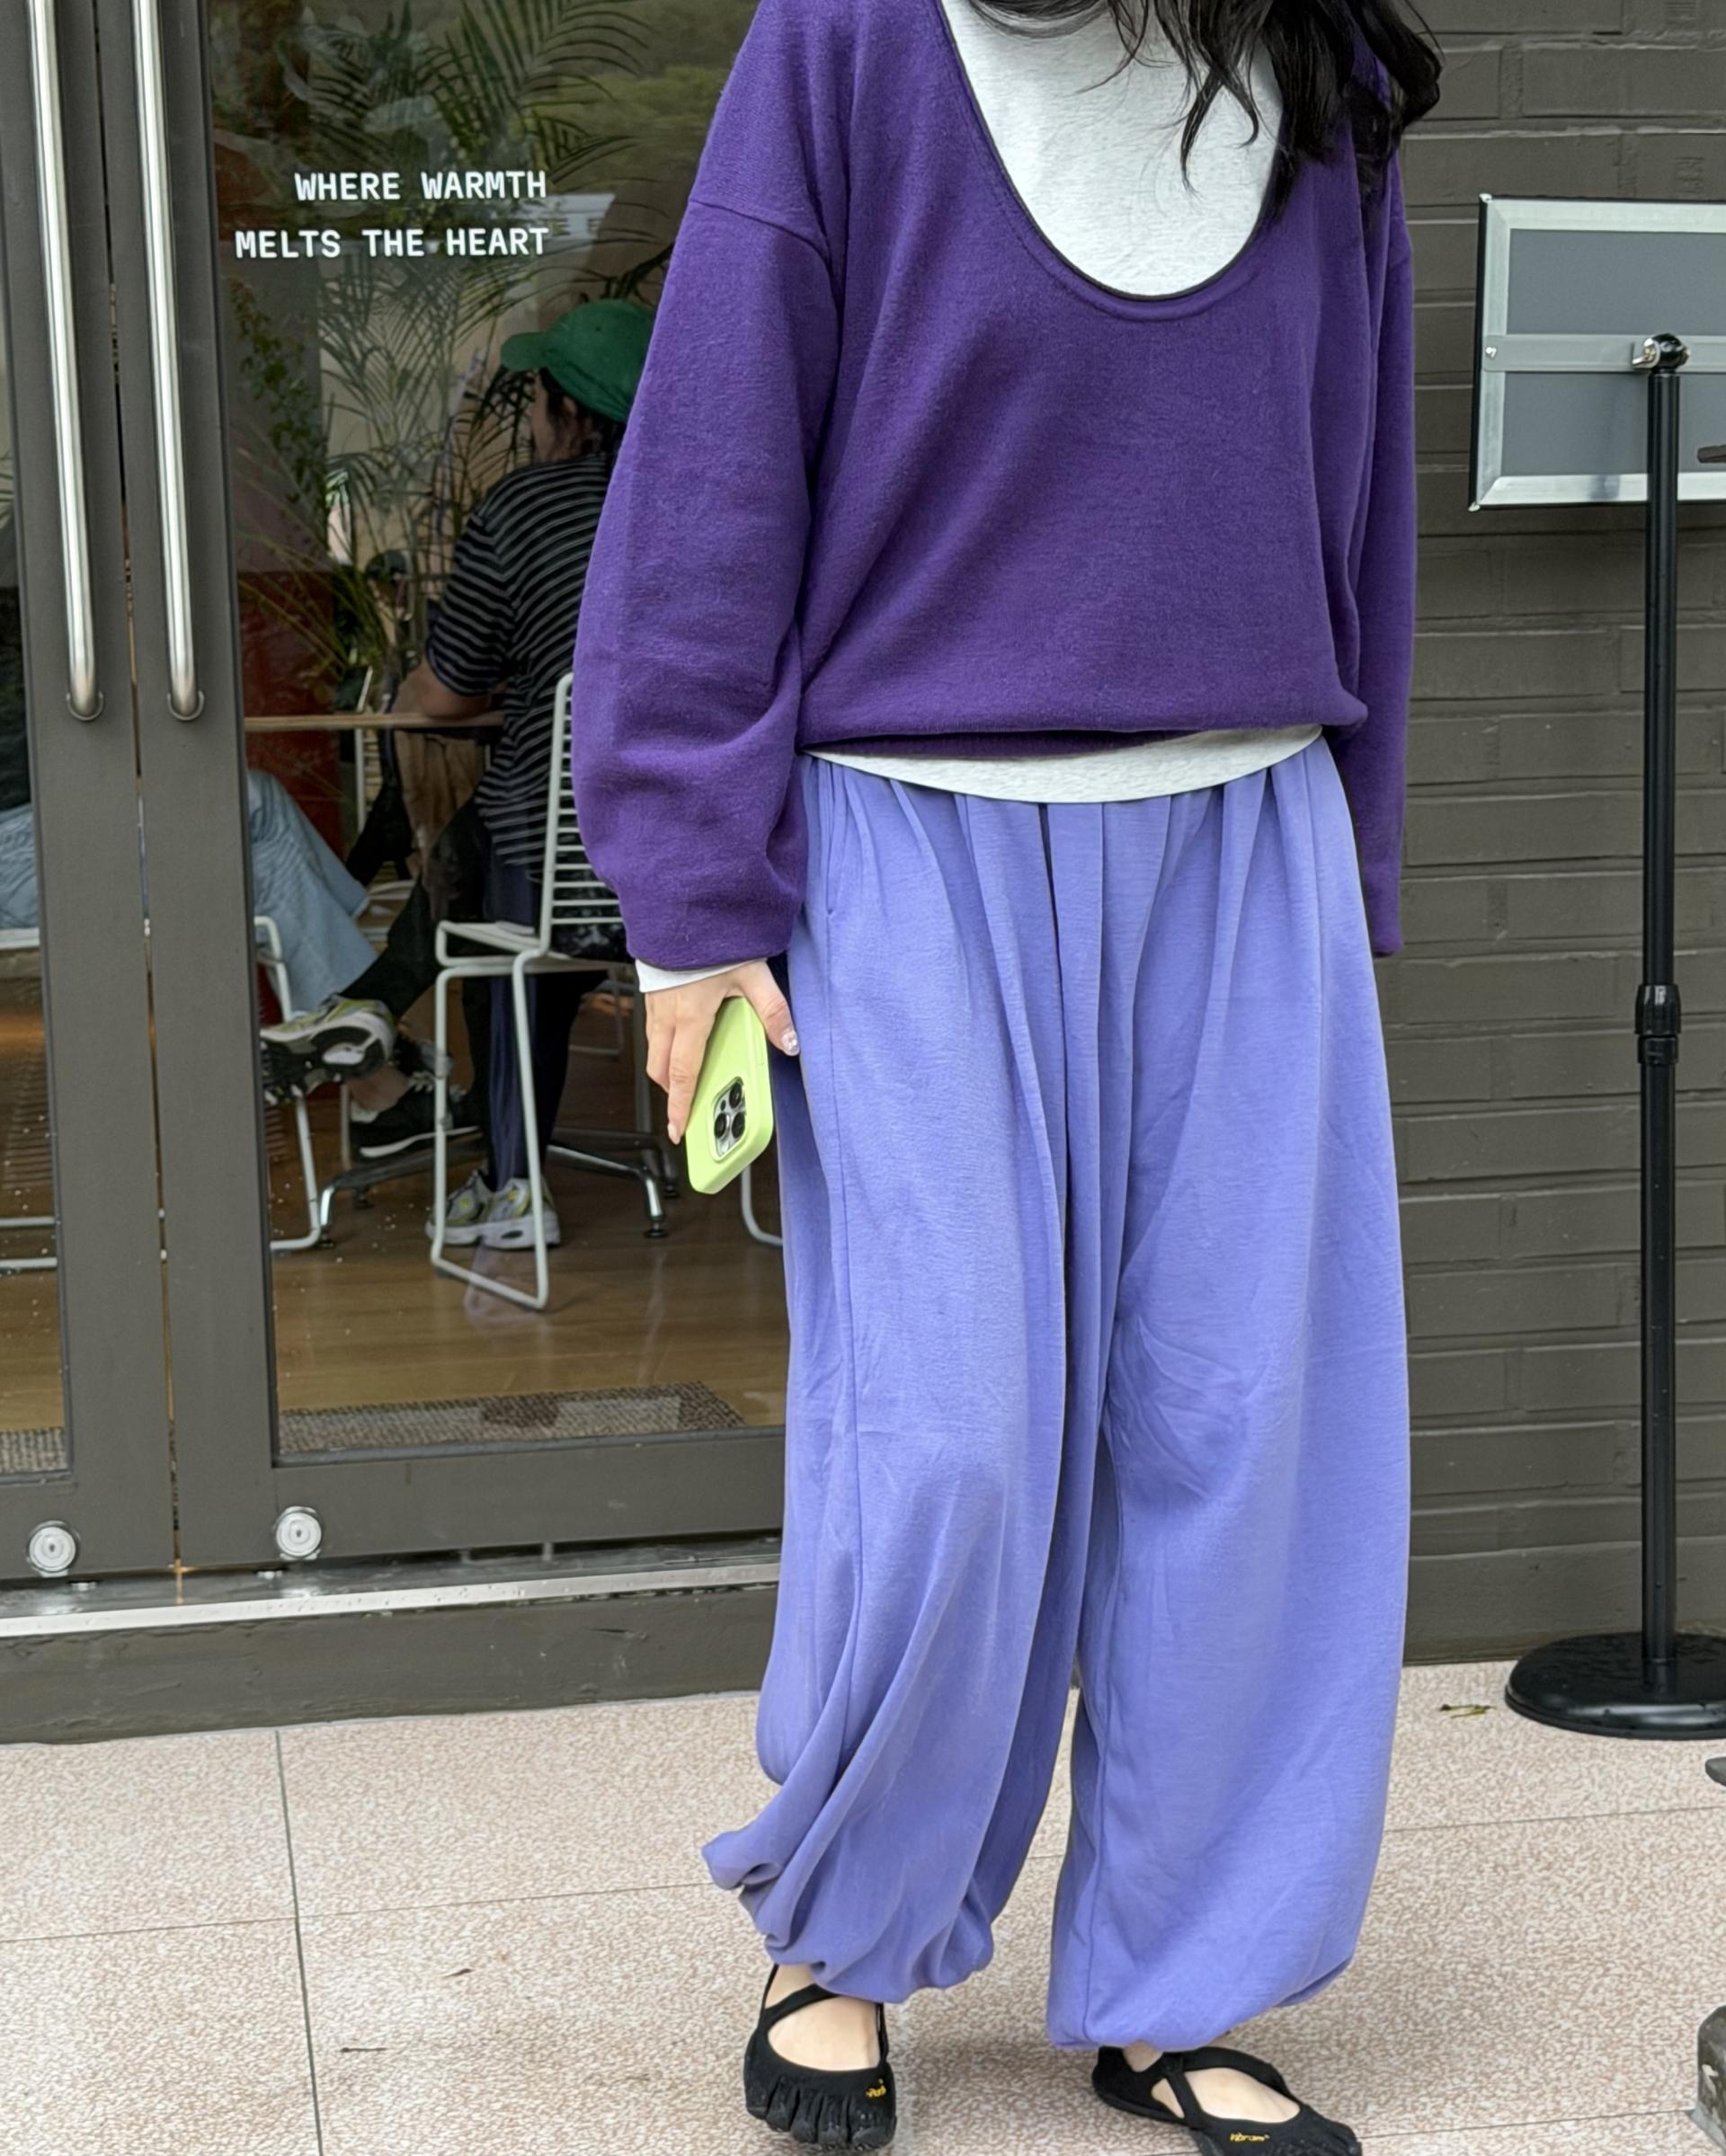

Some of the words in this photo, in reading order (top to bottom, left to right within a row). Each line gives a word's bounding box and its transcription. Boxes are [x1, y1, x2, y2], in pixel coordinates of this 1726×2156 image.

[294, 172, 401, 200] WHERE
[421, 170, 547, 200] WARMTH
[235, 229, 342, 259] MELTS
[361, 228, 425, 257] THE
[446, 227, 549, 256] HEART
